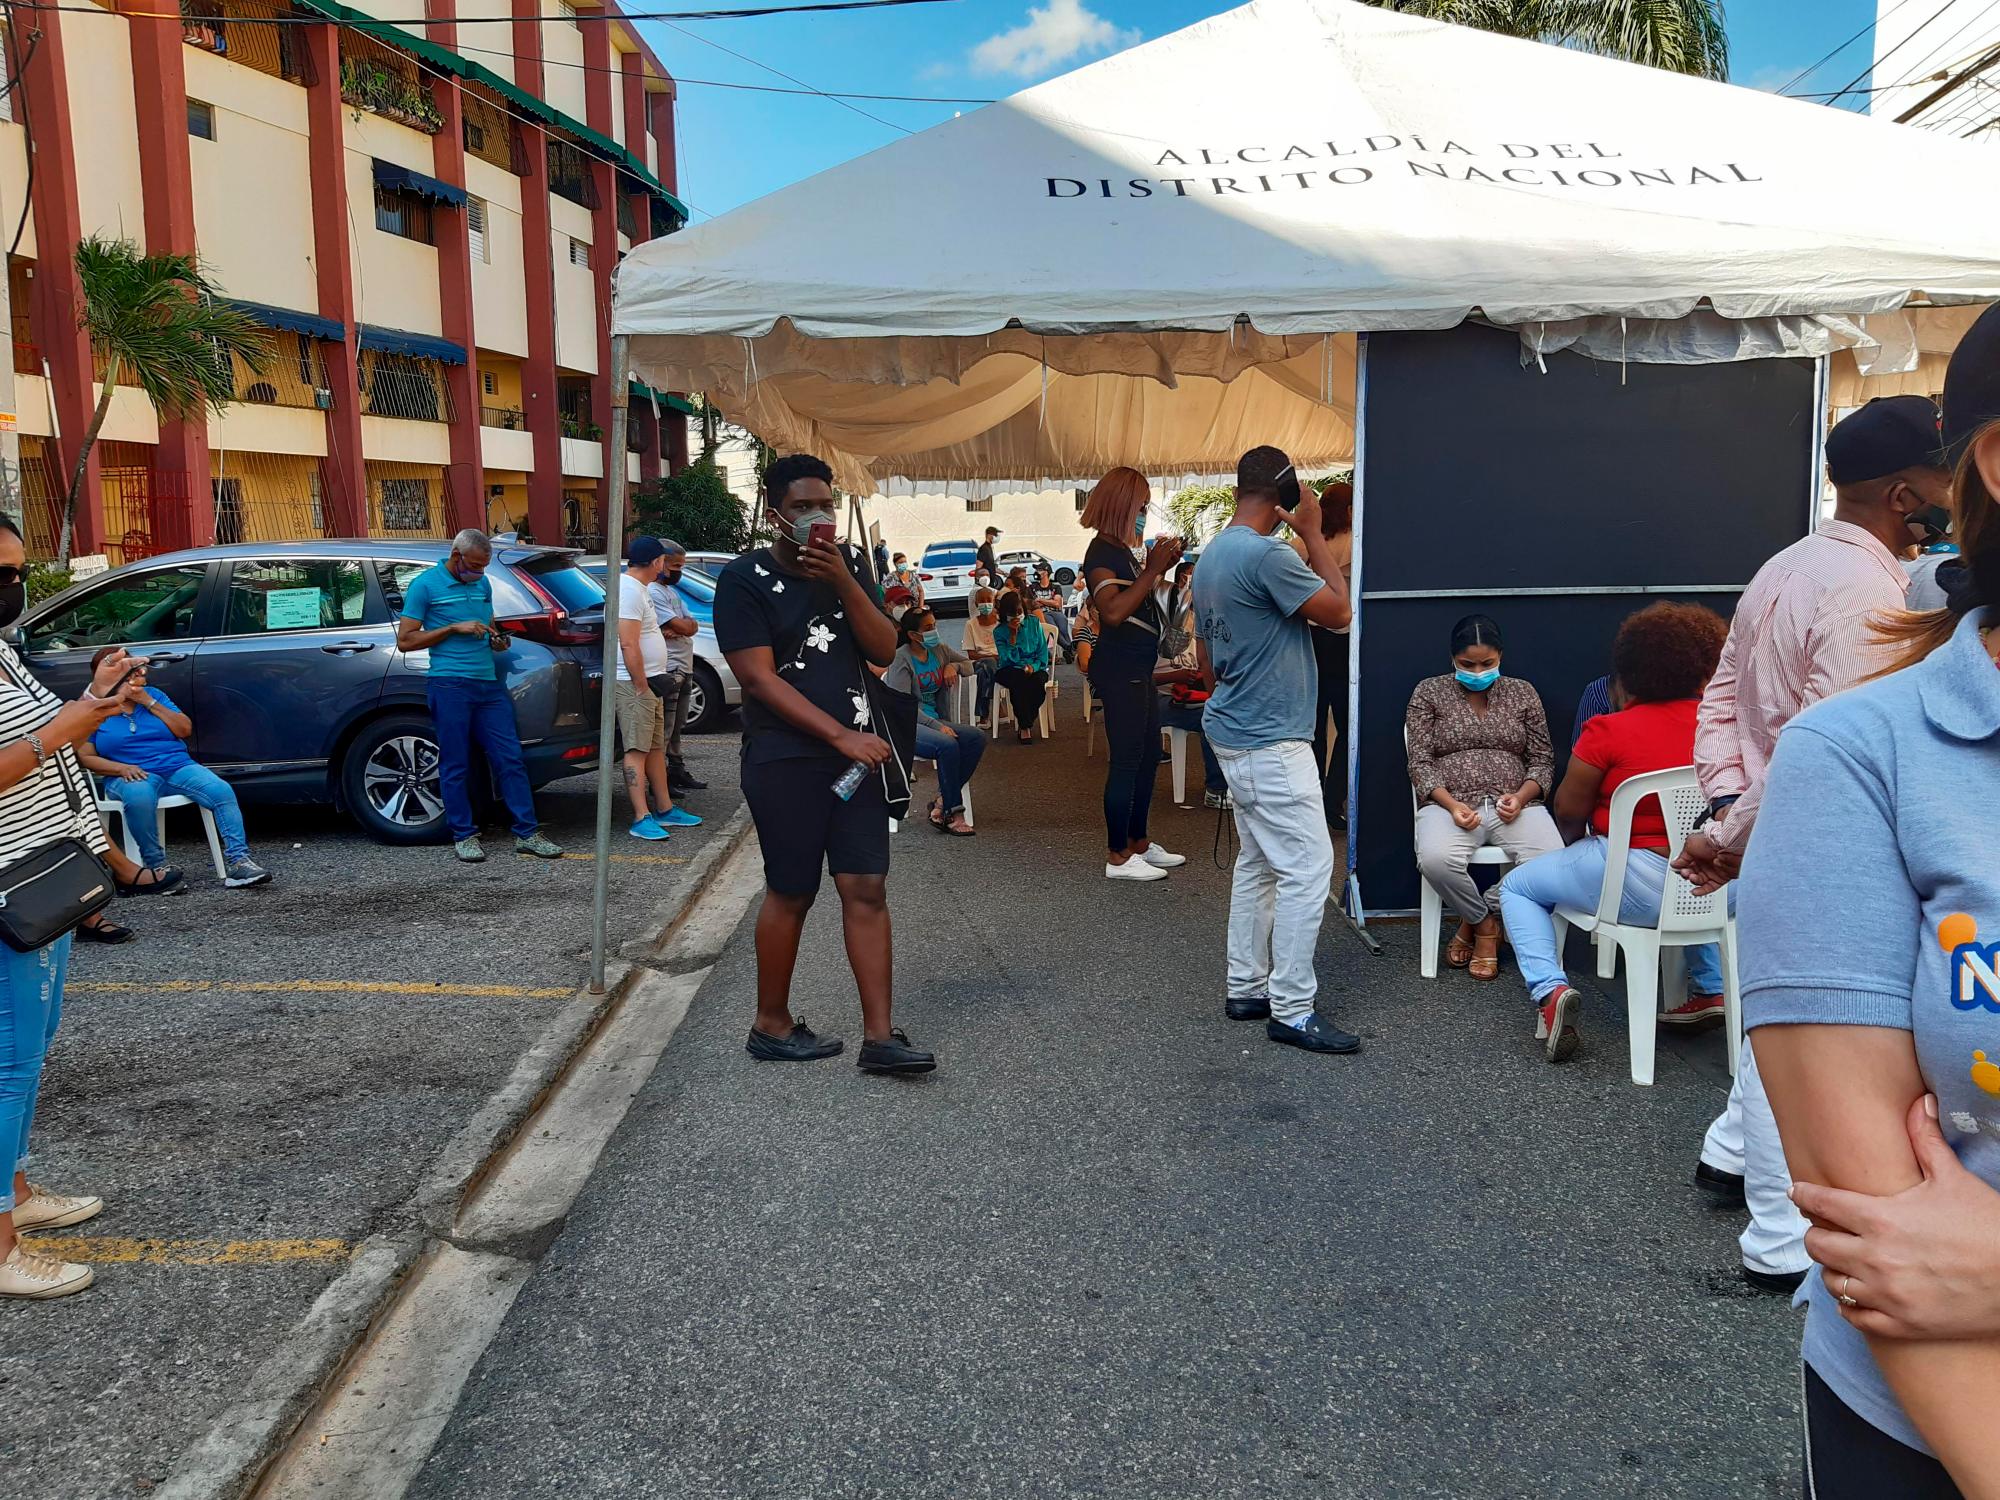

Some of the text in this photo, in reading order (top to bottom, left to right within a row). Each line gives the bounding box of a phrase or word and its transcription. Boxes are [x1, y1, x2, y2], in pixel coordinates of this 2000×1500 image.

[1497, 142, 1623, 159] DEL
[1043, 160, 1764, 198] DISTRITO NACIONAL
